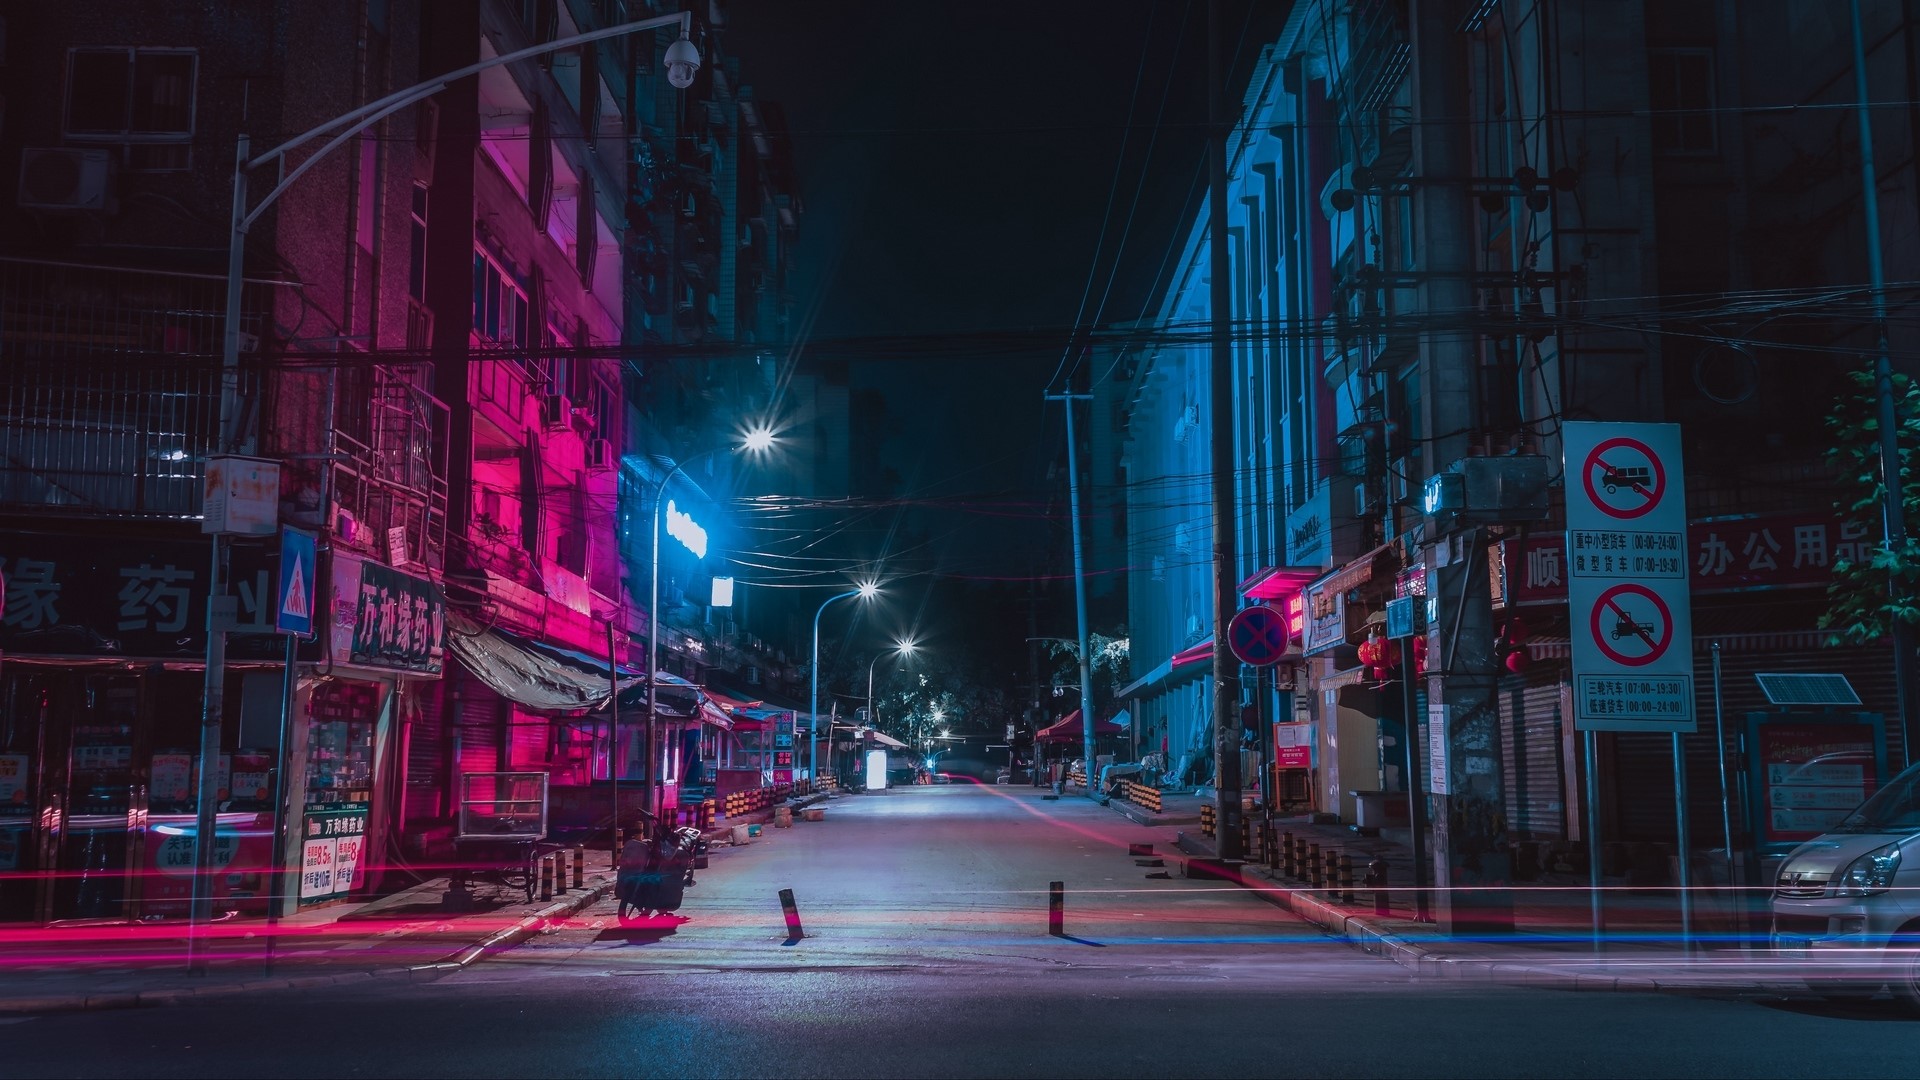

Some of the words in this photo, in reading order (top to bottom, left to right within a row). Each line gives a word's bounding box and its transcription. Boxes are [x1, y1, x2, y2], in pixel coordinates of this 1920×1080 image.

[1575, 532, 1627, 550] 重中小型货车
[1526, 546, 1561, 588] 顺
[1697, 522, 1874, 577] 办公用品
[1576, 555, 1628, 572] 微型货车
[359, 583, 445, 656] 万和缘药业
[1588, 680, 1624, 696] 三轮汽车
[1589, 698, 1625, 714] 低速货车
[325, 816, 364, 835] 万和缘药业
